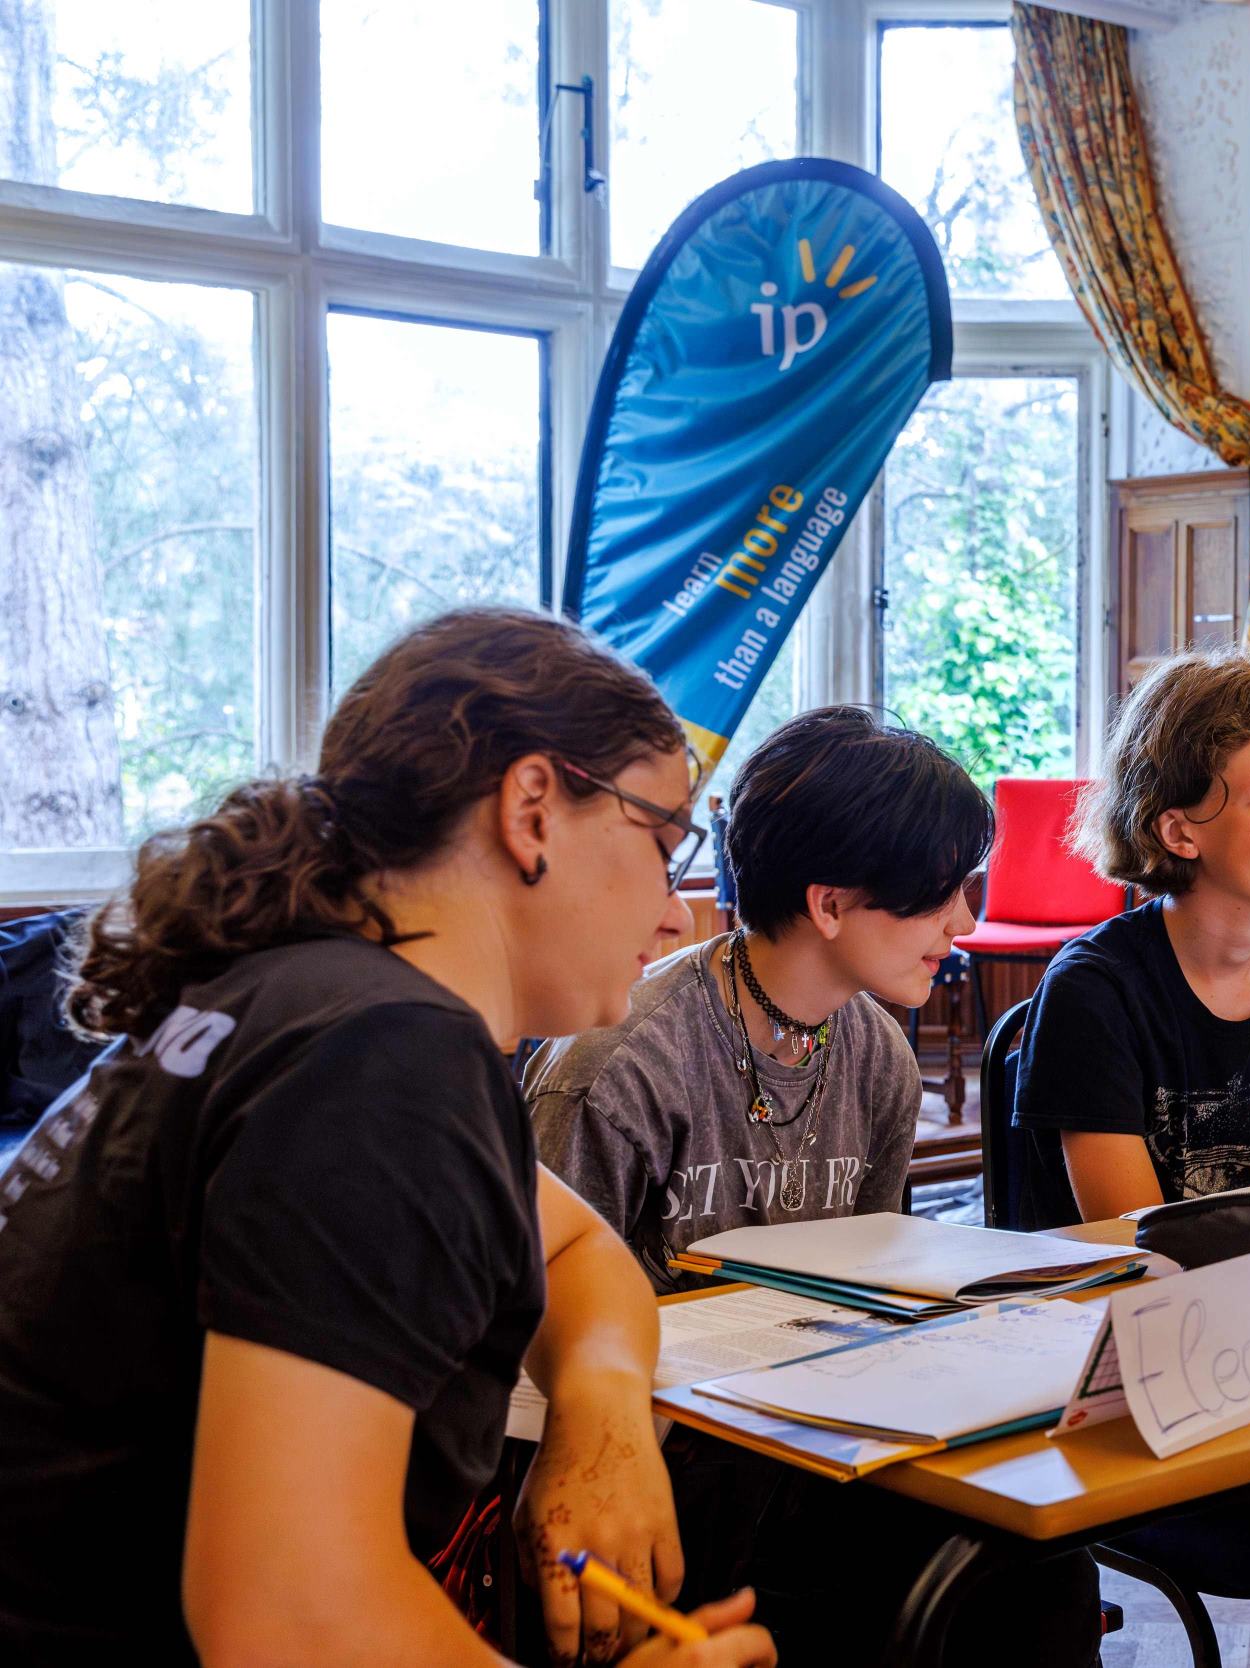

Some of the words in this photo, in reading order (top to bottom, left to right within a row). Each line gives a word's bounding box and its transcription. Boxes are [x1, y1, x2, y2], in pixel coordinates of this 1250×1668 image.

[750, 281, 828, 371] ip
[715, 485, 804, 599] more
[761, 486, 849, 606] language
[662, 551, 723, 617] learn
[756, 608, 781, 628] a
[714, 629, 768, 691] than
